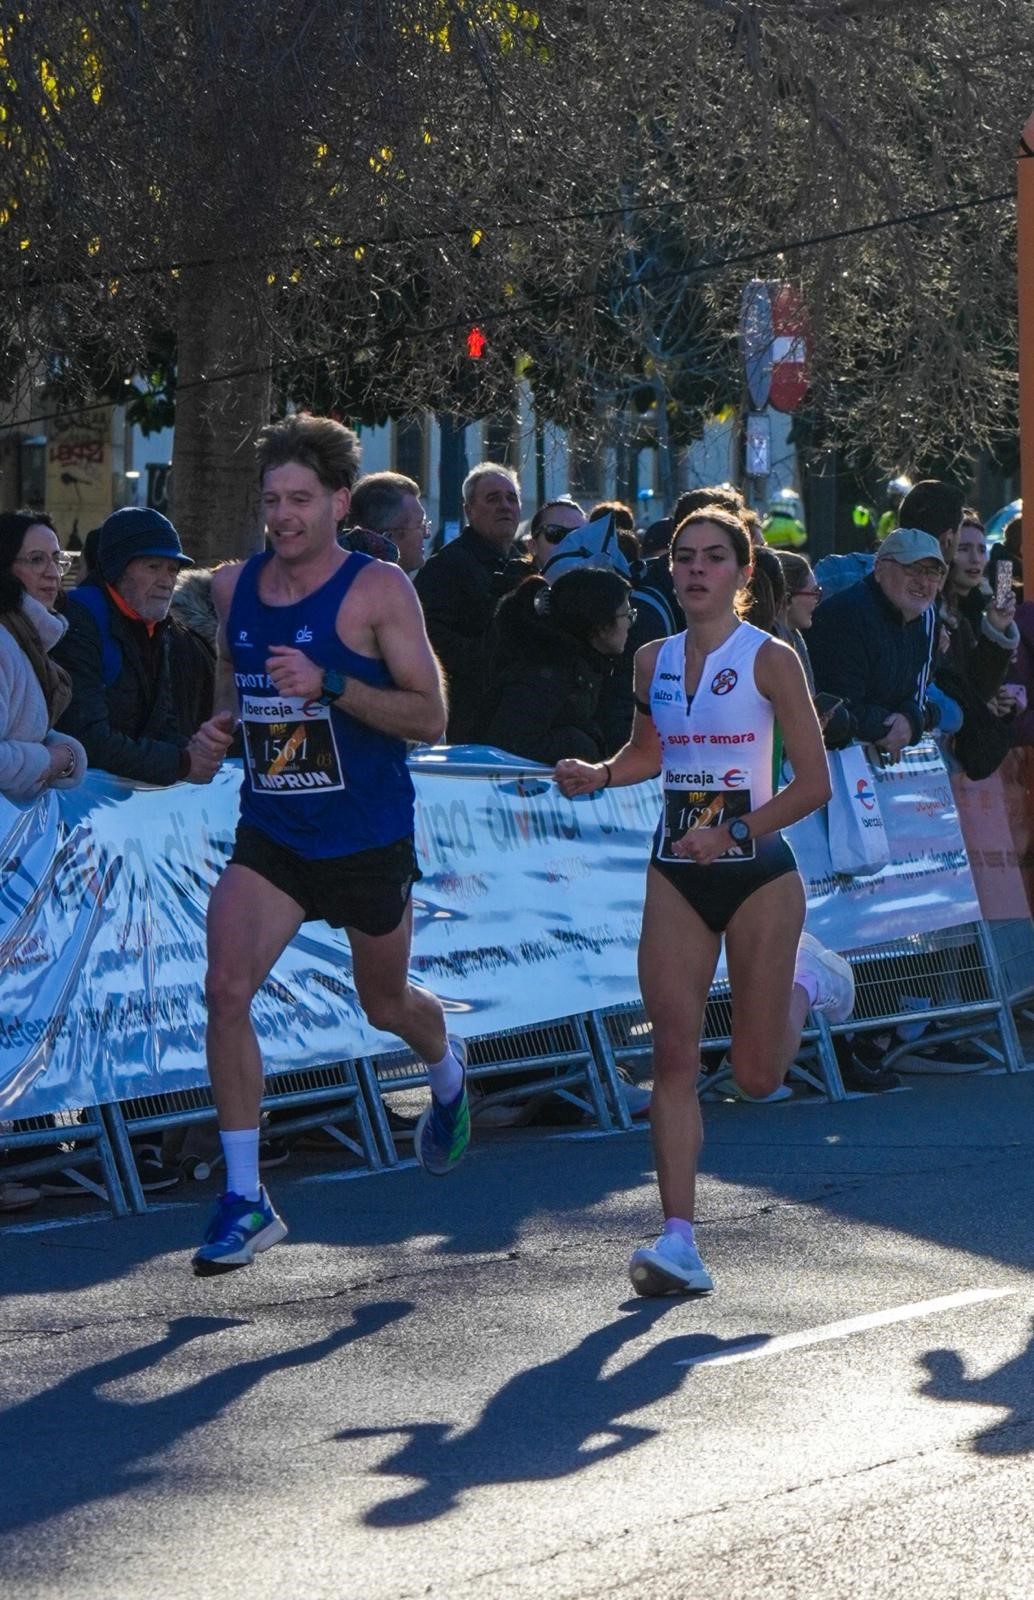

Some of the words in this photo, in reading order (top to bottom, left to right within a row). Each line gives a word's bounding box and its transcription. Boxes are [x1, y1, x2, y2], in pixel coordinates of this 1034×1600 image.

[244, 702, 294, 718] Ibercaja
[709, 731, 755, 744] amara
[264, 738, 308, 763] 1561
[665, 770, 714, 787] Ibercaja
[679, 807, 725, 832] 1621
